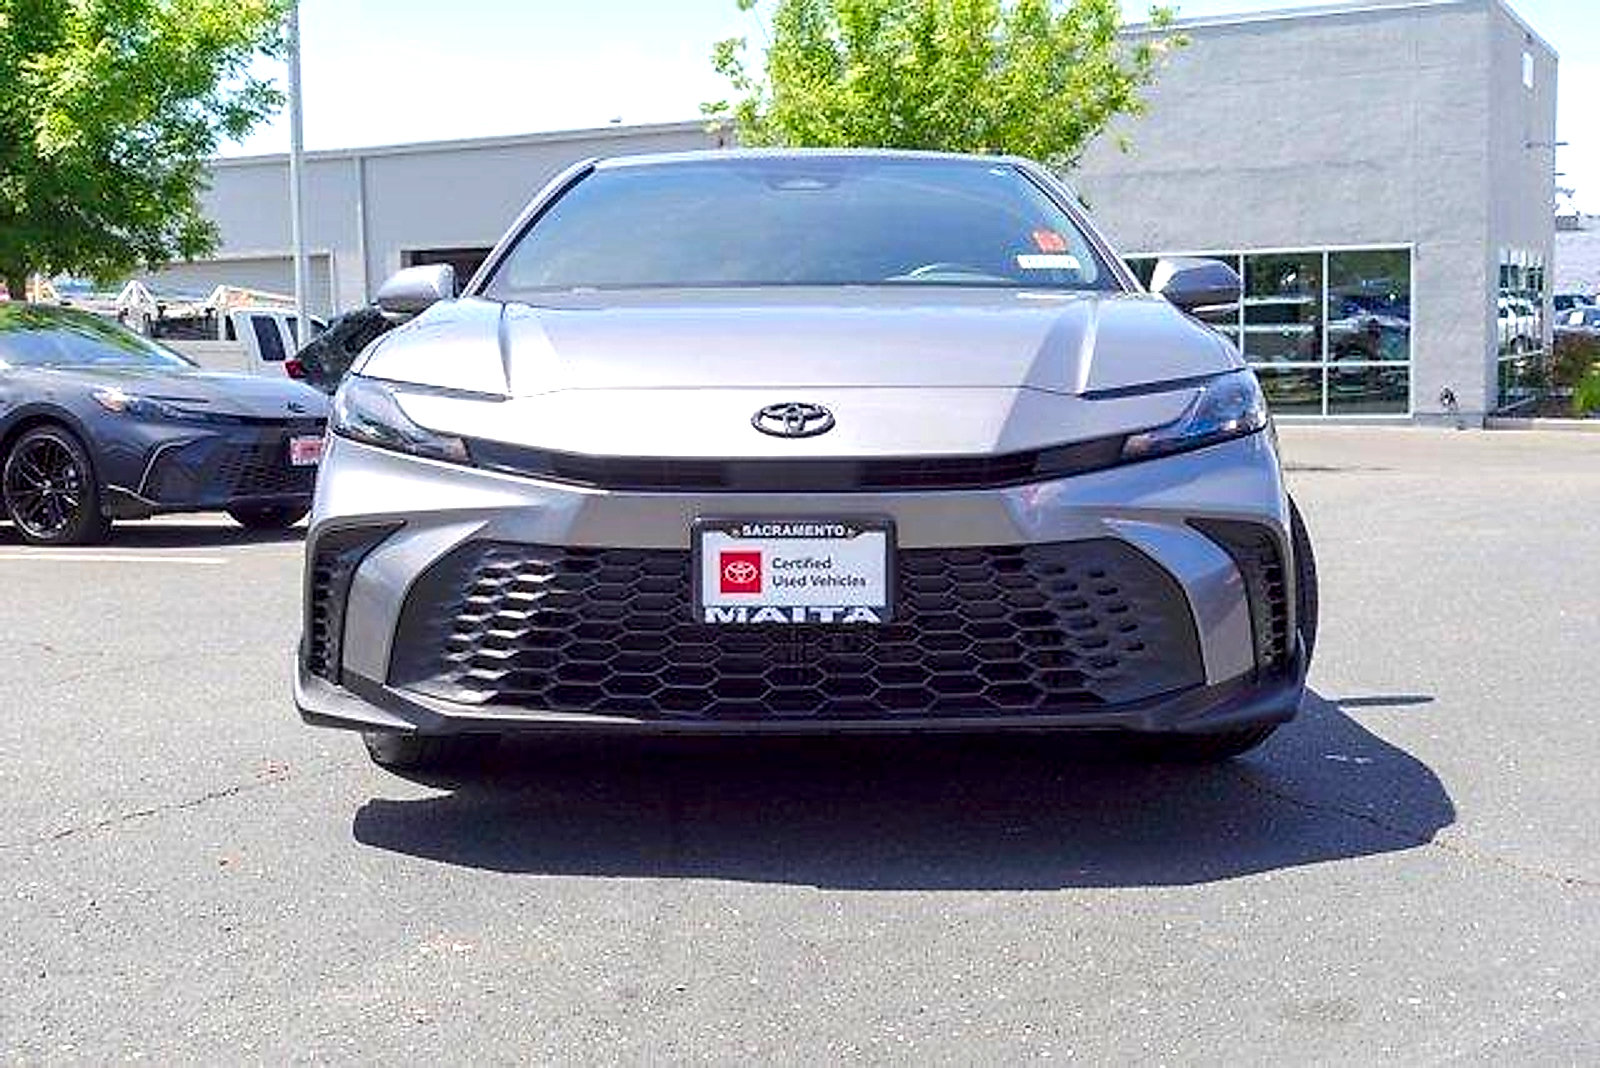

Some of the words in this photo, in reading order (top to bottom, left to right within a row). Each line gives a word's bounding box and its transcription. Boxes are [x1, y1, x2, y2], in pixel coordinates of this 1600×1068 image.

[742, 524, 844, 537] SACRAMENTO
[772, 556, 832, 570] Certified
[772, 574, 807, 588] Used
[810, 574, 866, 587] Vehicles
[704, 607, 882, 624] MAITA
